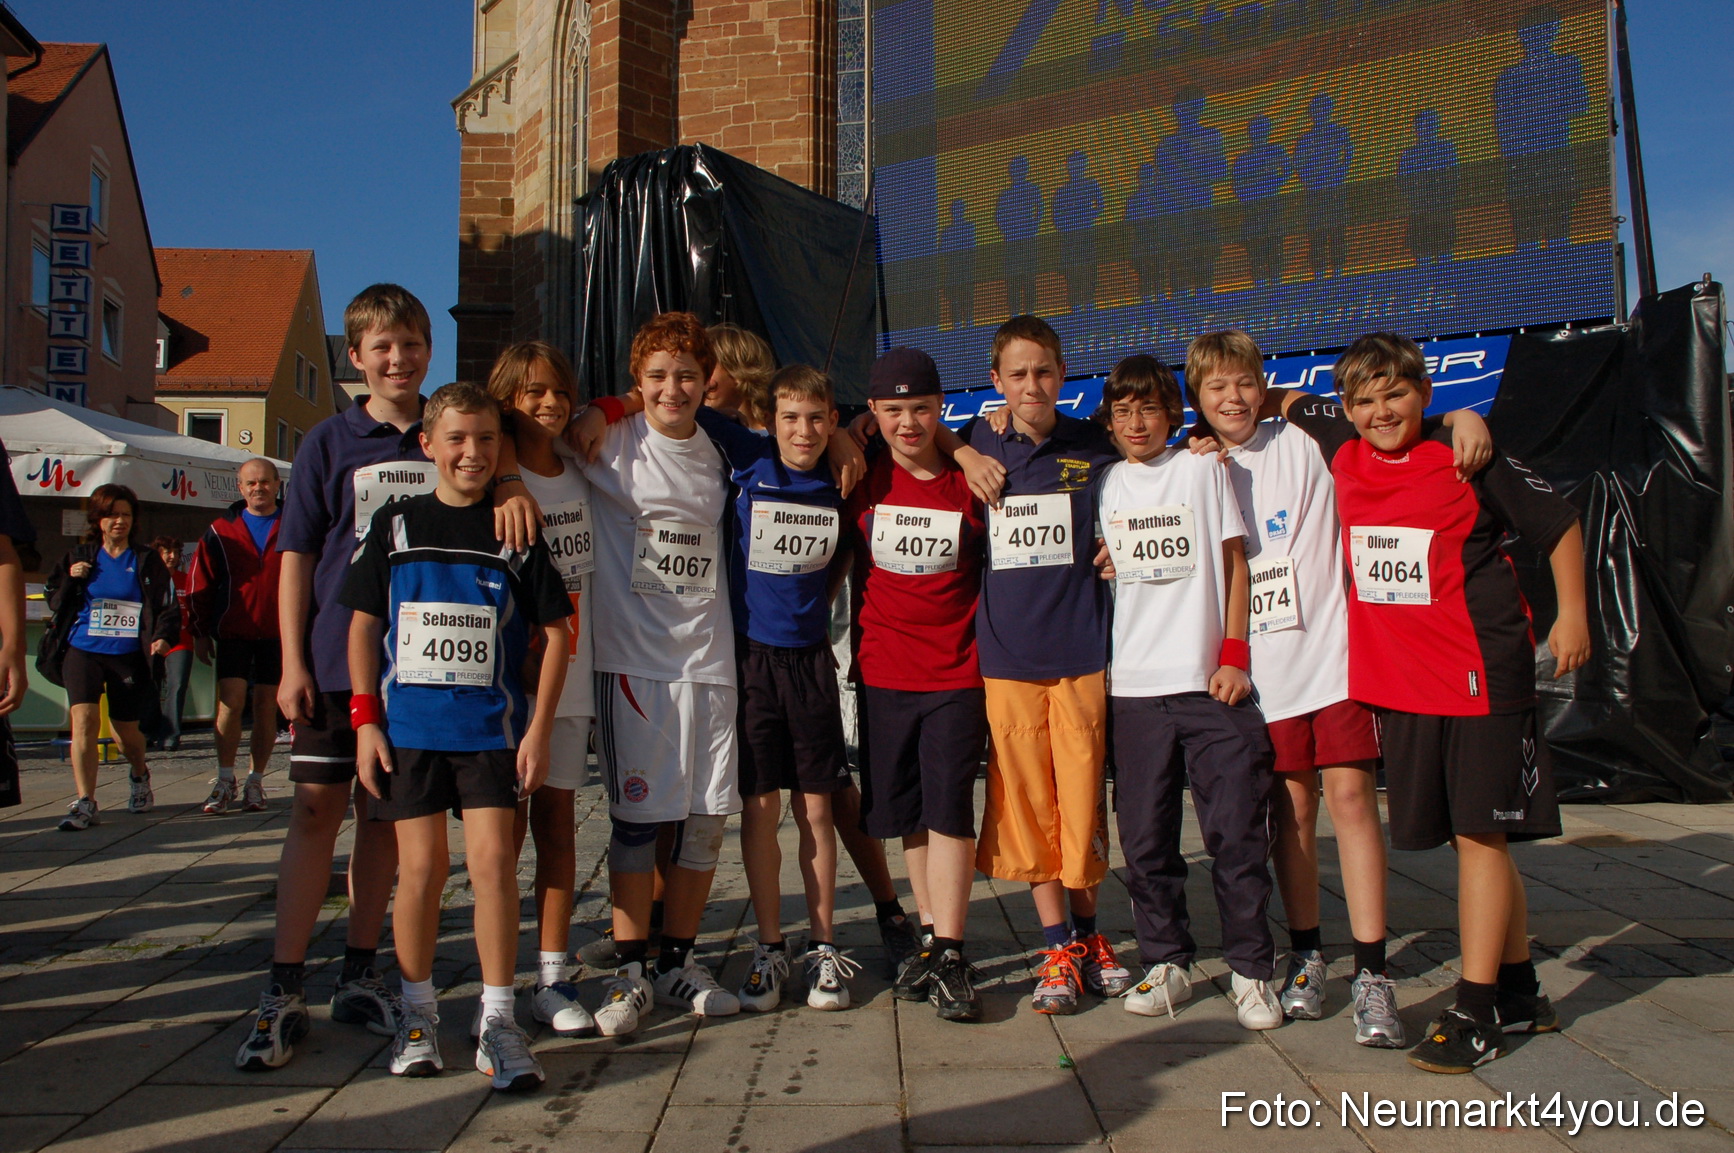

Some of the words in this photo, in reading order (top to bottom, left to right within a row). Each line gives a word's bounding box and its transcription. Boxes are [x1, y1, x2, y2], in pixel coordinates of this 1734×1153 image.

[56, 210, 81, 401] BETTEN
[378, 470, 425, 484] Philipp
[360, 489, 369, 502] J
[543, 507, 583, 528] Michael
[773, 511, 835, 527] Alexander
[1005, 502, 1038, 518] David
[896, 513, 932, 528] Georg
[1128, 514, 1182, 531] Matthias
[551, 531, 591, 559] 4068
[658, 530, 701, 546] Manuel
[755, 529, 763, 540] J
[773, 534, 829, 556] 4071
[877, 531, 885, 542] J
[895, 536, 953, 557] 4072
[993, 526, 999, 537] J
[1008, 524, 1066, 548] 4070
[1367, 535, 1400, 550] Oliver
[1115, 539, 1122, 551] J
[1132, 536, 1190, 561] 4069
[638, 547, 647, 559] J
[657, 554, 712, 578] 4067
[1354, 555, 1360, 567] J
[1368, 560, 1423, 583] 4064
[1251, 566, 1289, 586] xander
[1251, 586, 1291, 615] 074
[103, 614, 136, 627] 2769
[422, 611, 491, 630] Sebastian
[403, 633, 411, 646] J
[422, 638, 489, 664] 4098
